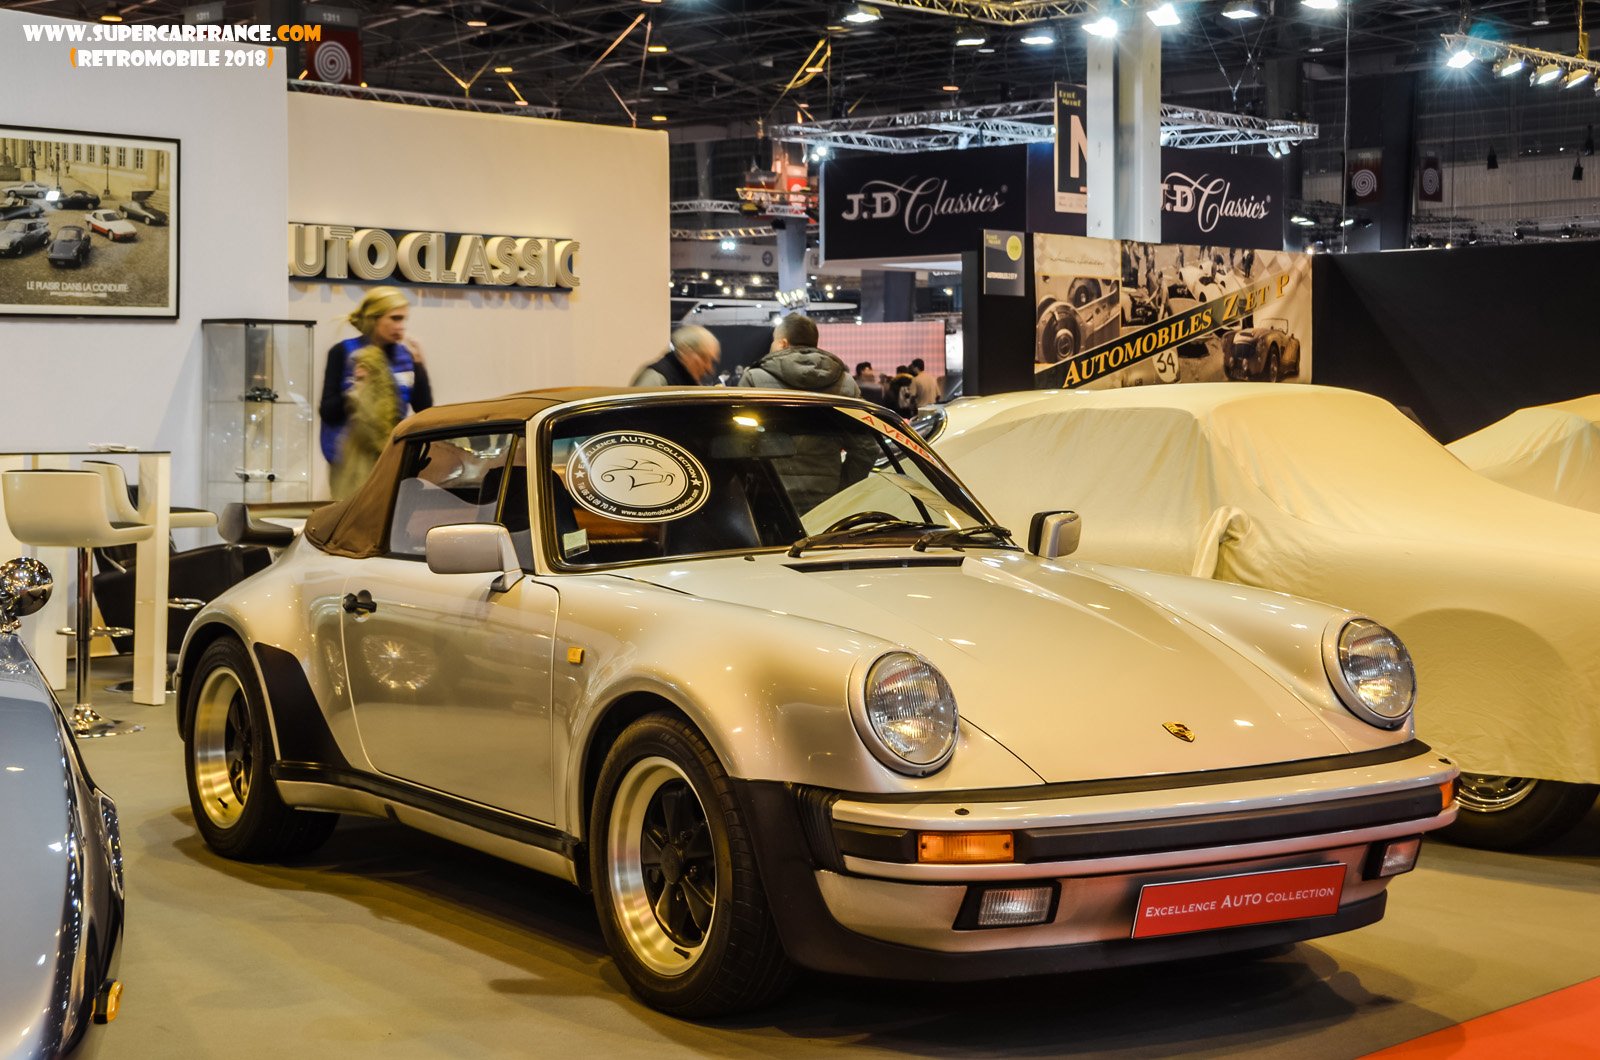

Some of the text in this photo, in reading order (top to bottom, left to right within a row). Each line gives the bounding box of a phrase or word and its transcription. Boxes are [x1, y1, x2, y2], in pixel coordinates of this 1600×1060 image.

[195, 12, 210, 21] 1311
[322, 13, 340, 22] 1311
[841, 191, 899, 221] J.D
[288, 222, 580, 288] UTOCLASSIC
[26, 281, 34, 290] LE
[35, 281, 60, 291] PLAISIR
[61, 282, 82, 291] DANS
[82, 283, 92, 292] LA
[1062, 308, 1213, 389] AUTOMOBILES
[1222, 294, 1239, 321] Z
[1245, 285, 1270, 312] ET
[1276, 274, 1290, 298] P
[861, 415, 935, 463] A VEND
[620, 435, 655, 446] AUTO
[656, 443, 697, 479] COLLECTION
[1221, 892, 1262, 908] AUTO
